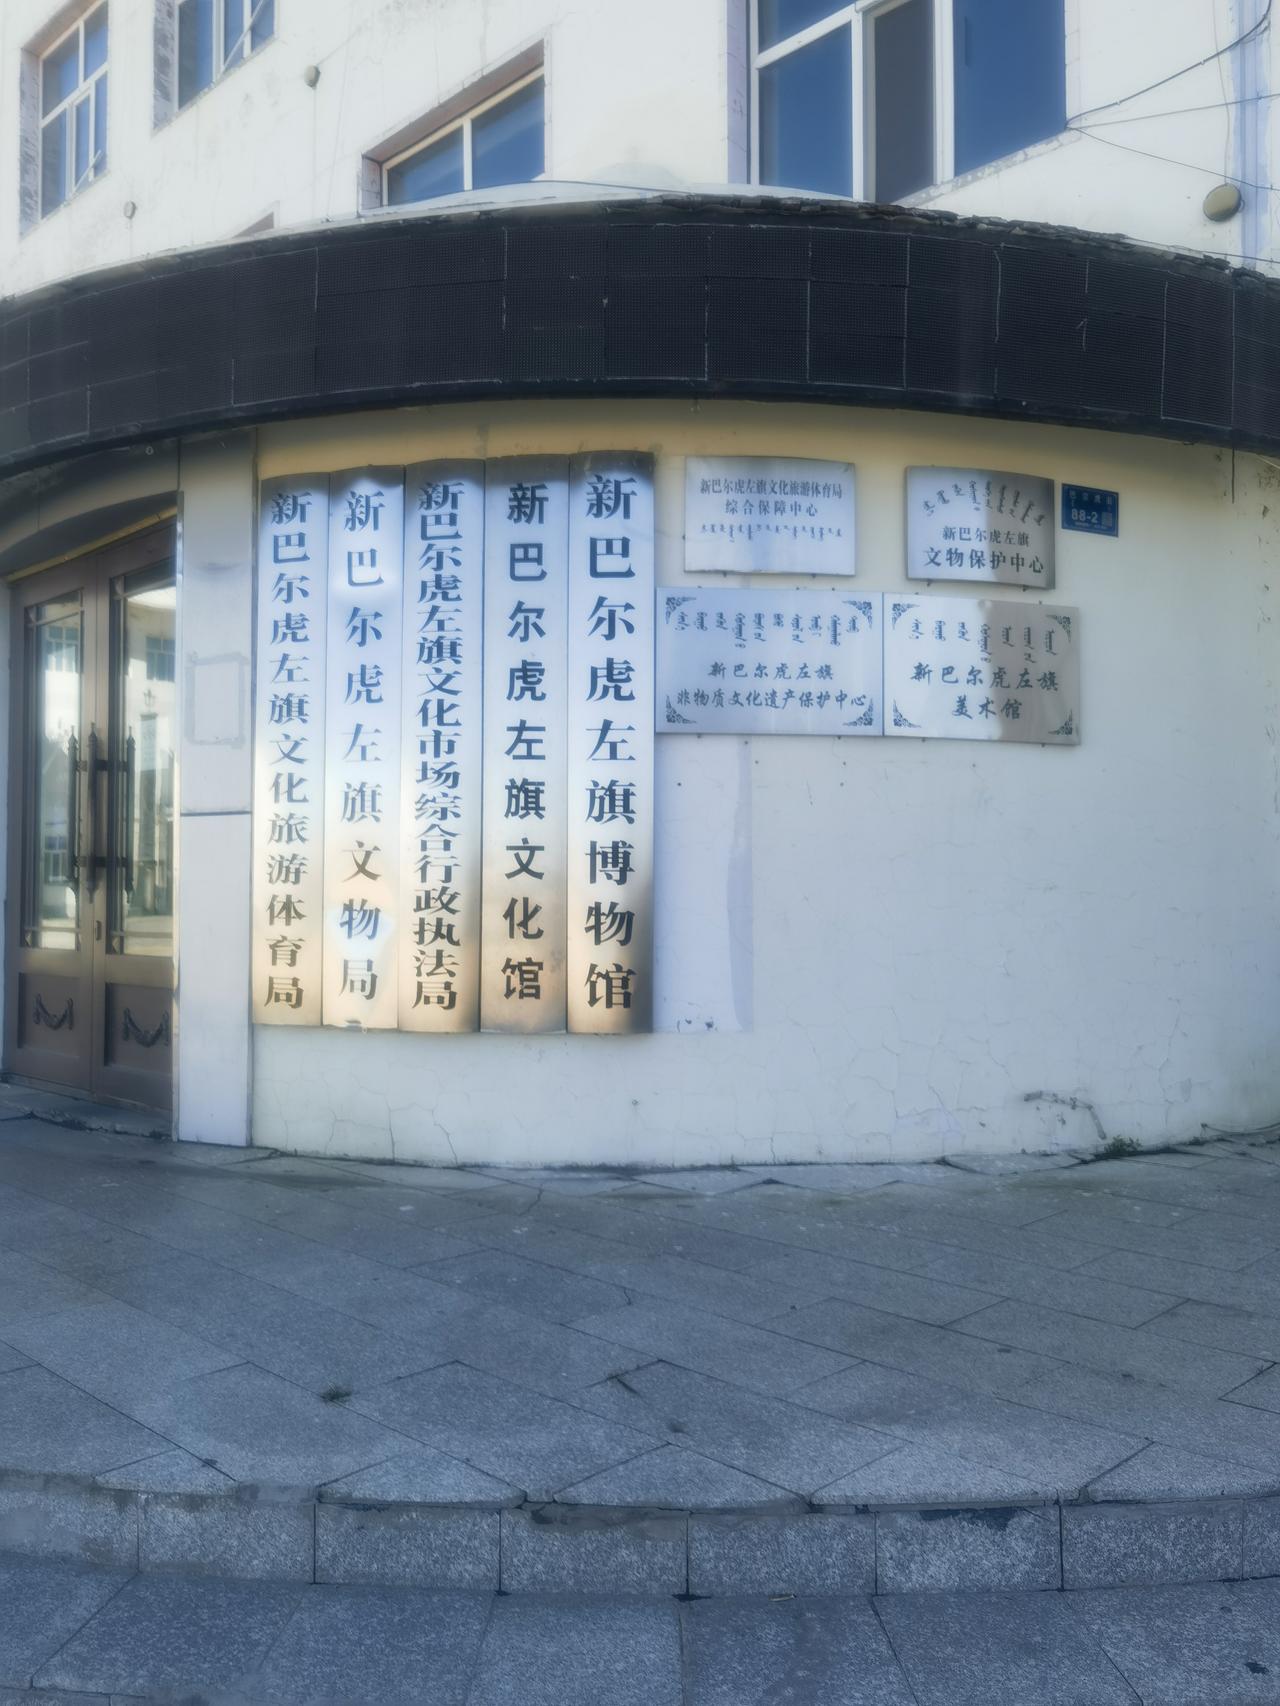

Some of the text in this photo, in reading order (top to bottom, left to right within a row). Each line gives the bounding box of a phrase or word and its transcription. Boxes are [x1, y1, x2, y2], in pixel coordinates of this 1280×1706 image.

[700, 478, 842, 499] 新巴尔虎左旗文化旅游体育局
[725, 499, 818, 517] 综合保障中心
[942, 525, 1030, 548] 新巴尔虎左旗
[924, 547, 1044, 574] 文物保护中心
[708, 661, 833, 680] 新巴尔虎左旗
[910, 662, 1059, 692] 新巴尔虎左旗
[677, 688, 867, 710] 非物质文化遗产保护中心
[952, 694, 1022, 720] 美术馆
[264, 490, 313, 1010] 新巴尔虎左旗文化旅游体育局
[338, 489, 386, 1001] 新巴尔虎左旗文物局
[411, 481, 465, 1011] 新巴尔虎左旗文化市场综合行政执法局
[500, 482, 550, 1000] 新巴尔虎左旗文化馆
[585, 474, 639, 1010] 新巴尔虎左旗博物馆
